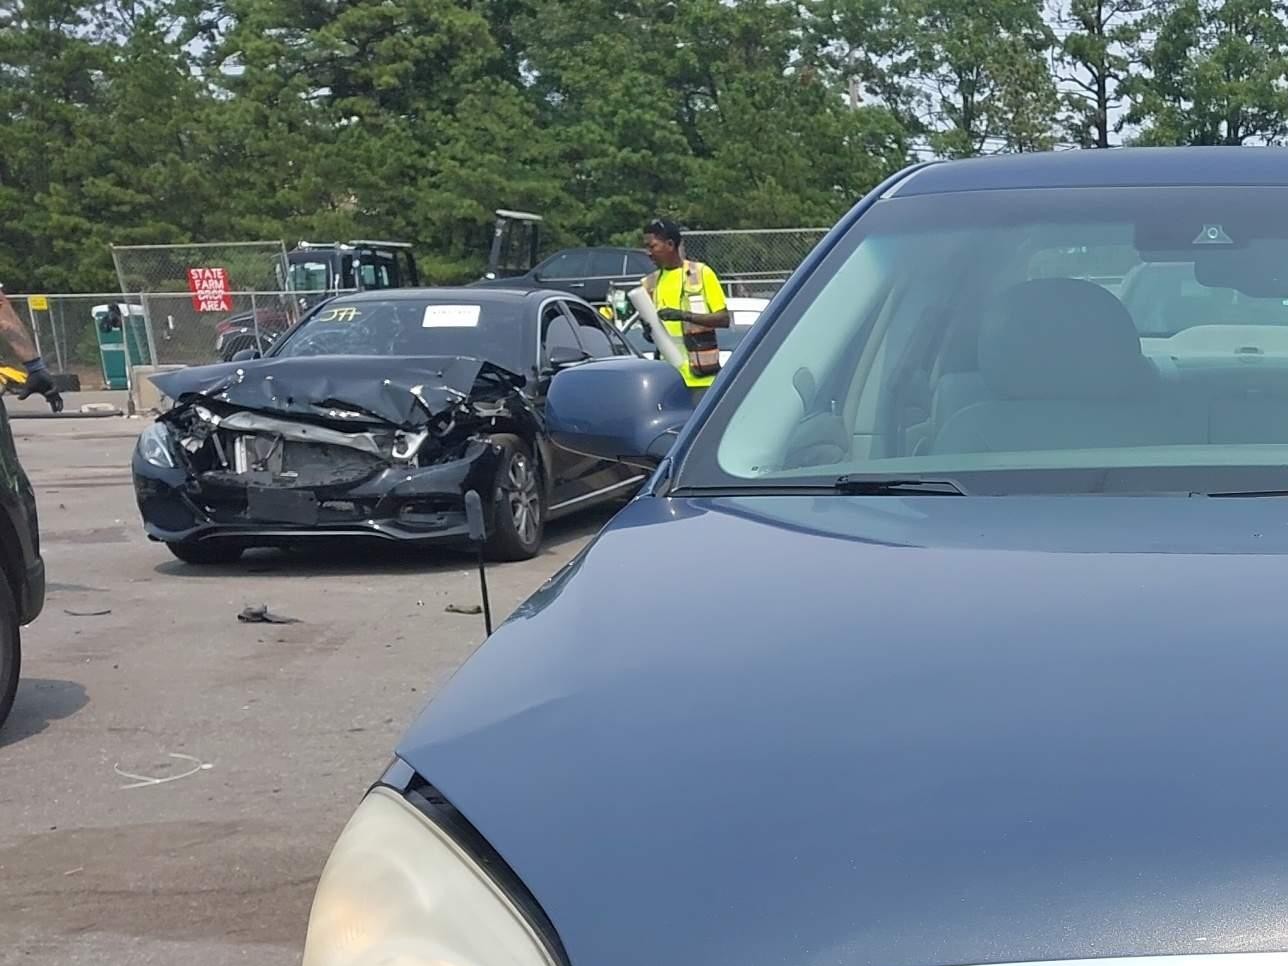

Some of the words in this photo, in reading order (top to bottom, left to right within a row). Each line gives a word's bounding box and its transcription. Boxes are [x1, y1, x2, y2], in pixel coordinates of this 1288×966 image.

[190, 268, 225, 280] STATE
[194, 279, 225, 290] FARM
[200, 300, 229, 312] AREA
